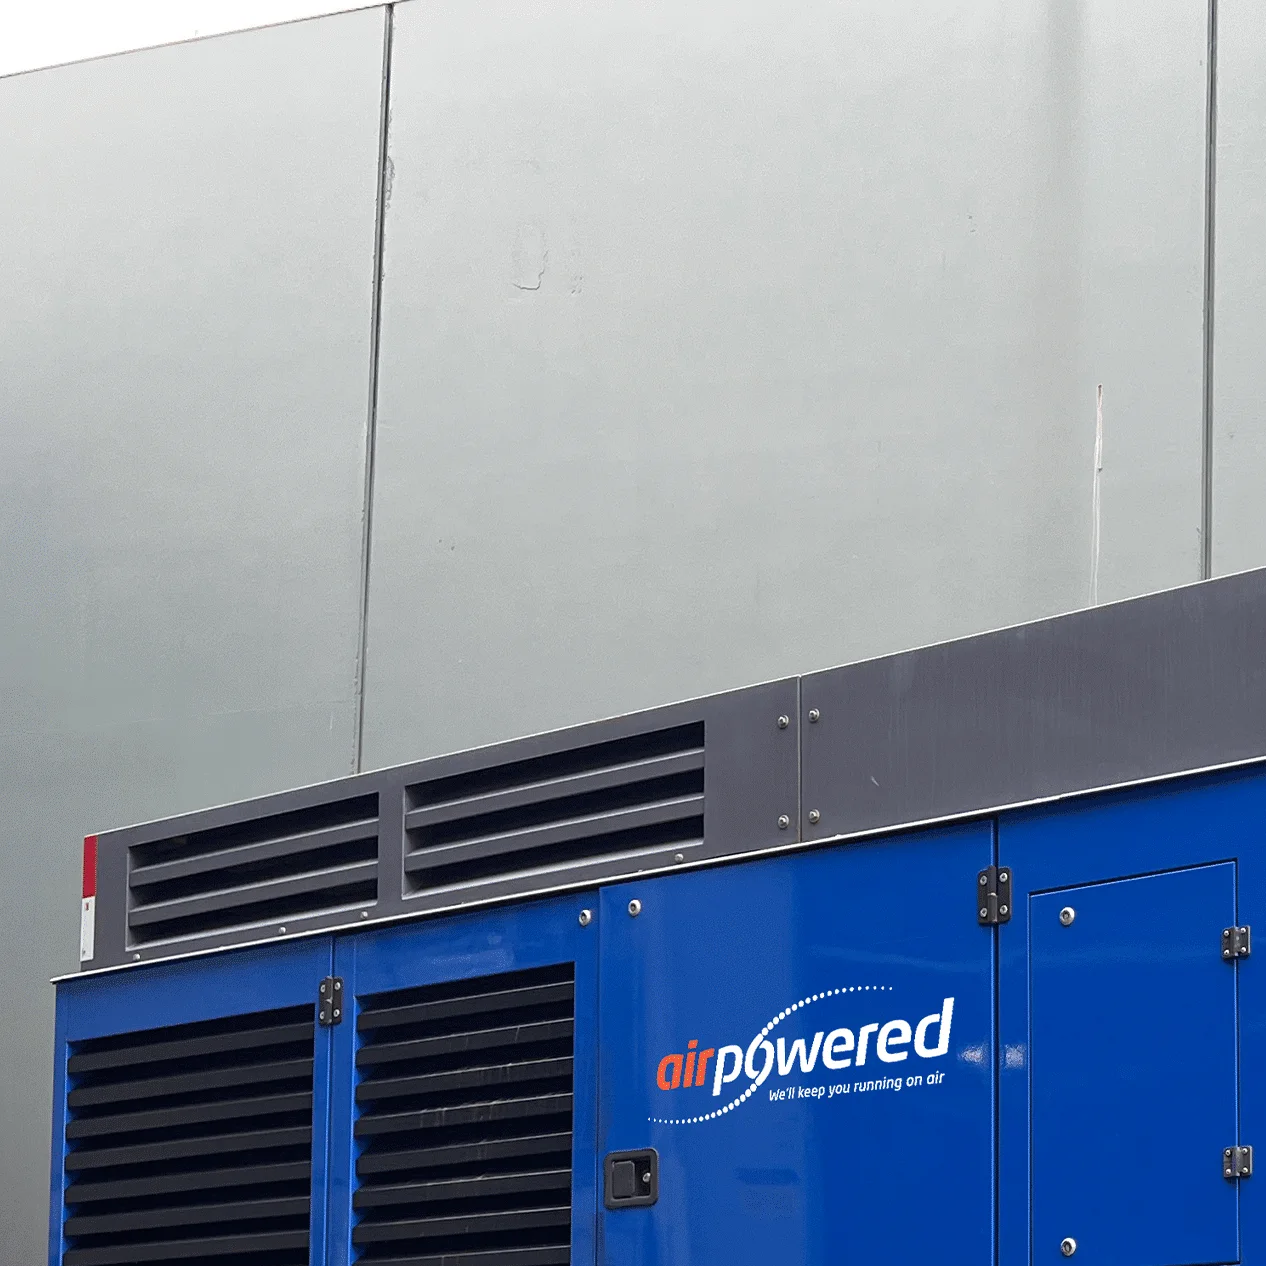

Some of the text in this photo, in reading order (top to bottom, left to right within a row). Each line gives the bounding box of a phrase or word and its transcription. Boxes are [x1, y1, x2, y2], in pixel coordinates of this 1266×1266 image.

[656, 997, 955, 1096] airpowered
[769, 1070, 945, 1101] We'll keep you running on air
